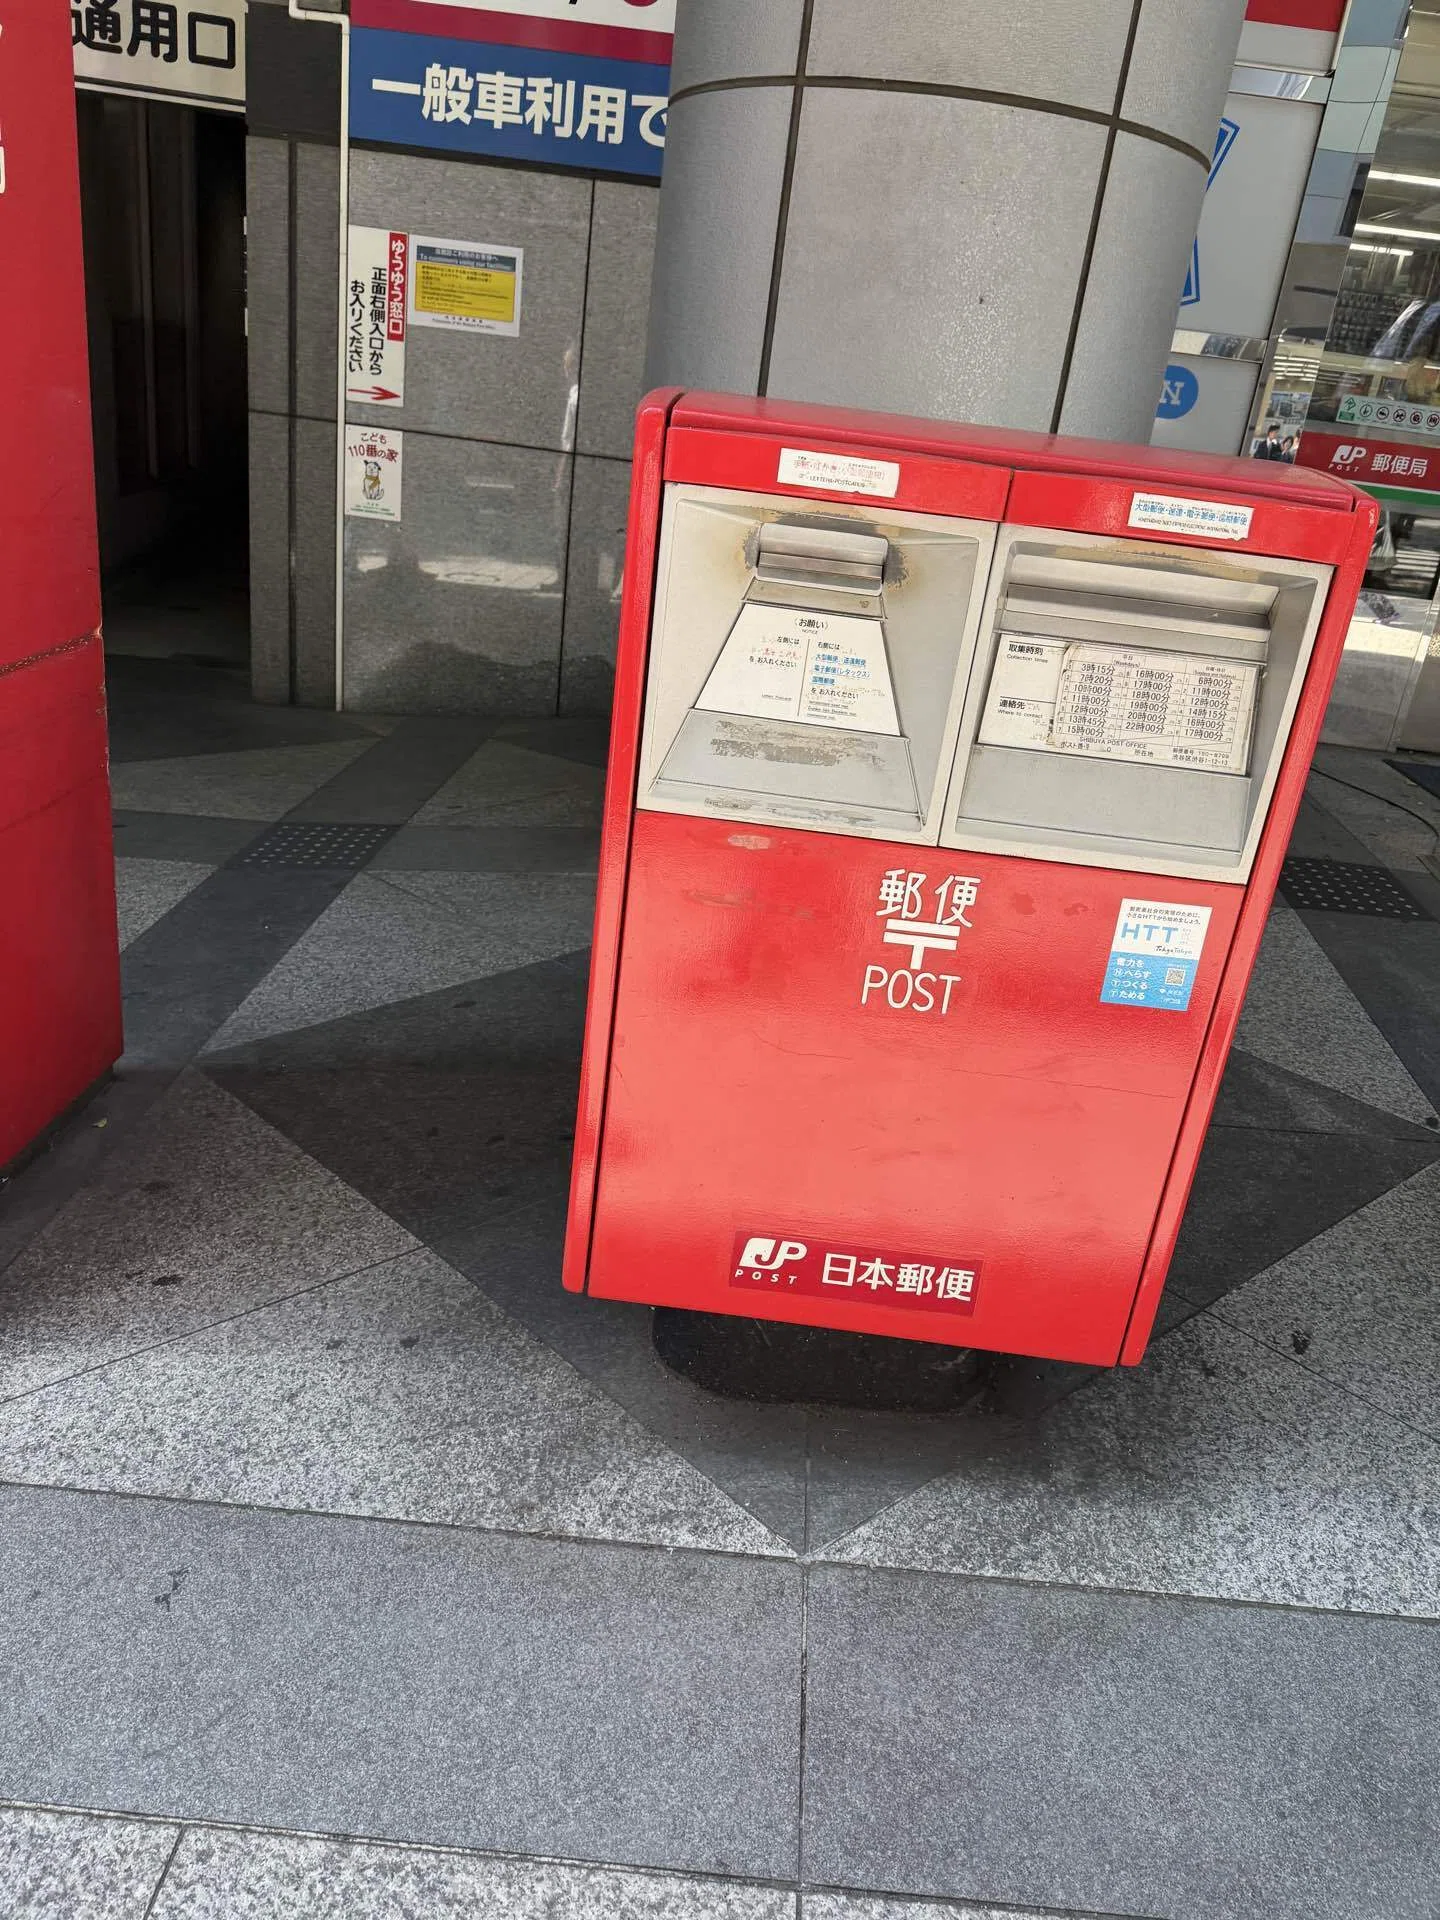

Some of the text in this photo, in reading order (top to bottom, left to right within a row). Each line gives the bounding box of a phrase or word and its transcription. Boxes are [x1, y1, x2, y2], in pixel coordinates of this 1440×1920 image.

[71, 0, 237, 69] 通用口
[371, 62, 668, 149] 一般車利用で
[388, 239, 406, 335] ゆうゆう窓口
[349, 279, 365, 373] お入りください
[369, 266, 387, 376] 正面右側入口から
[361, 432, 387, 444] こども
[348, 444, 399, 463] 110番の家
[1328, 463, 1360, 472] POST
[1371, 453, 1428, 477] 郵便局
[1009, 643, 1044, 655] 取集時刻
[999, 699, 1026, 710] 連絡先
[1125, 741, 1147, 749] OFFICE
[876, 868, 981, 928] 郵便
[1121, 922, 1179, 943] HTT
[861, 964, 962, 1015] POST
[738, 1237, 808, 1270] JP
[734, 1269, 798, 1285] POST
[821, 1252, 975, 1303] 日本郵便
